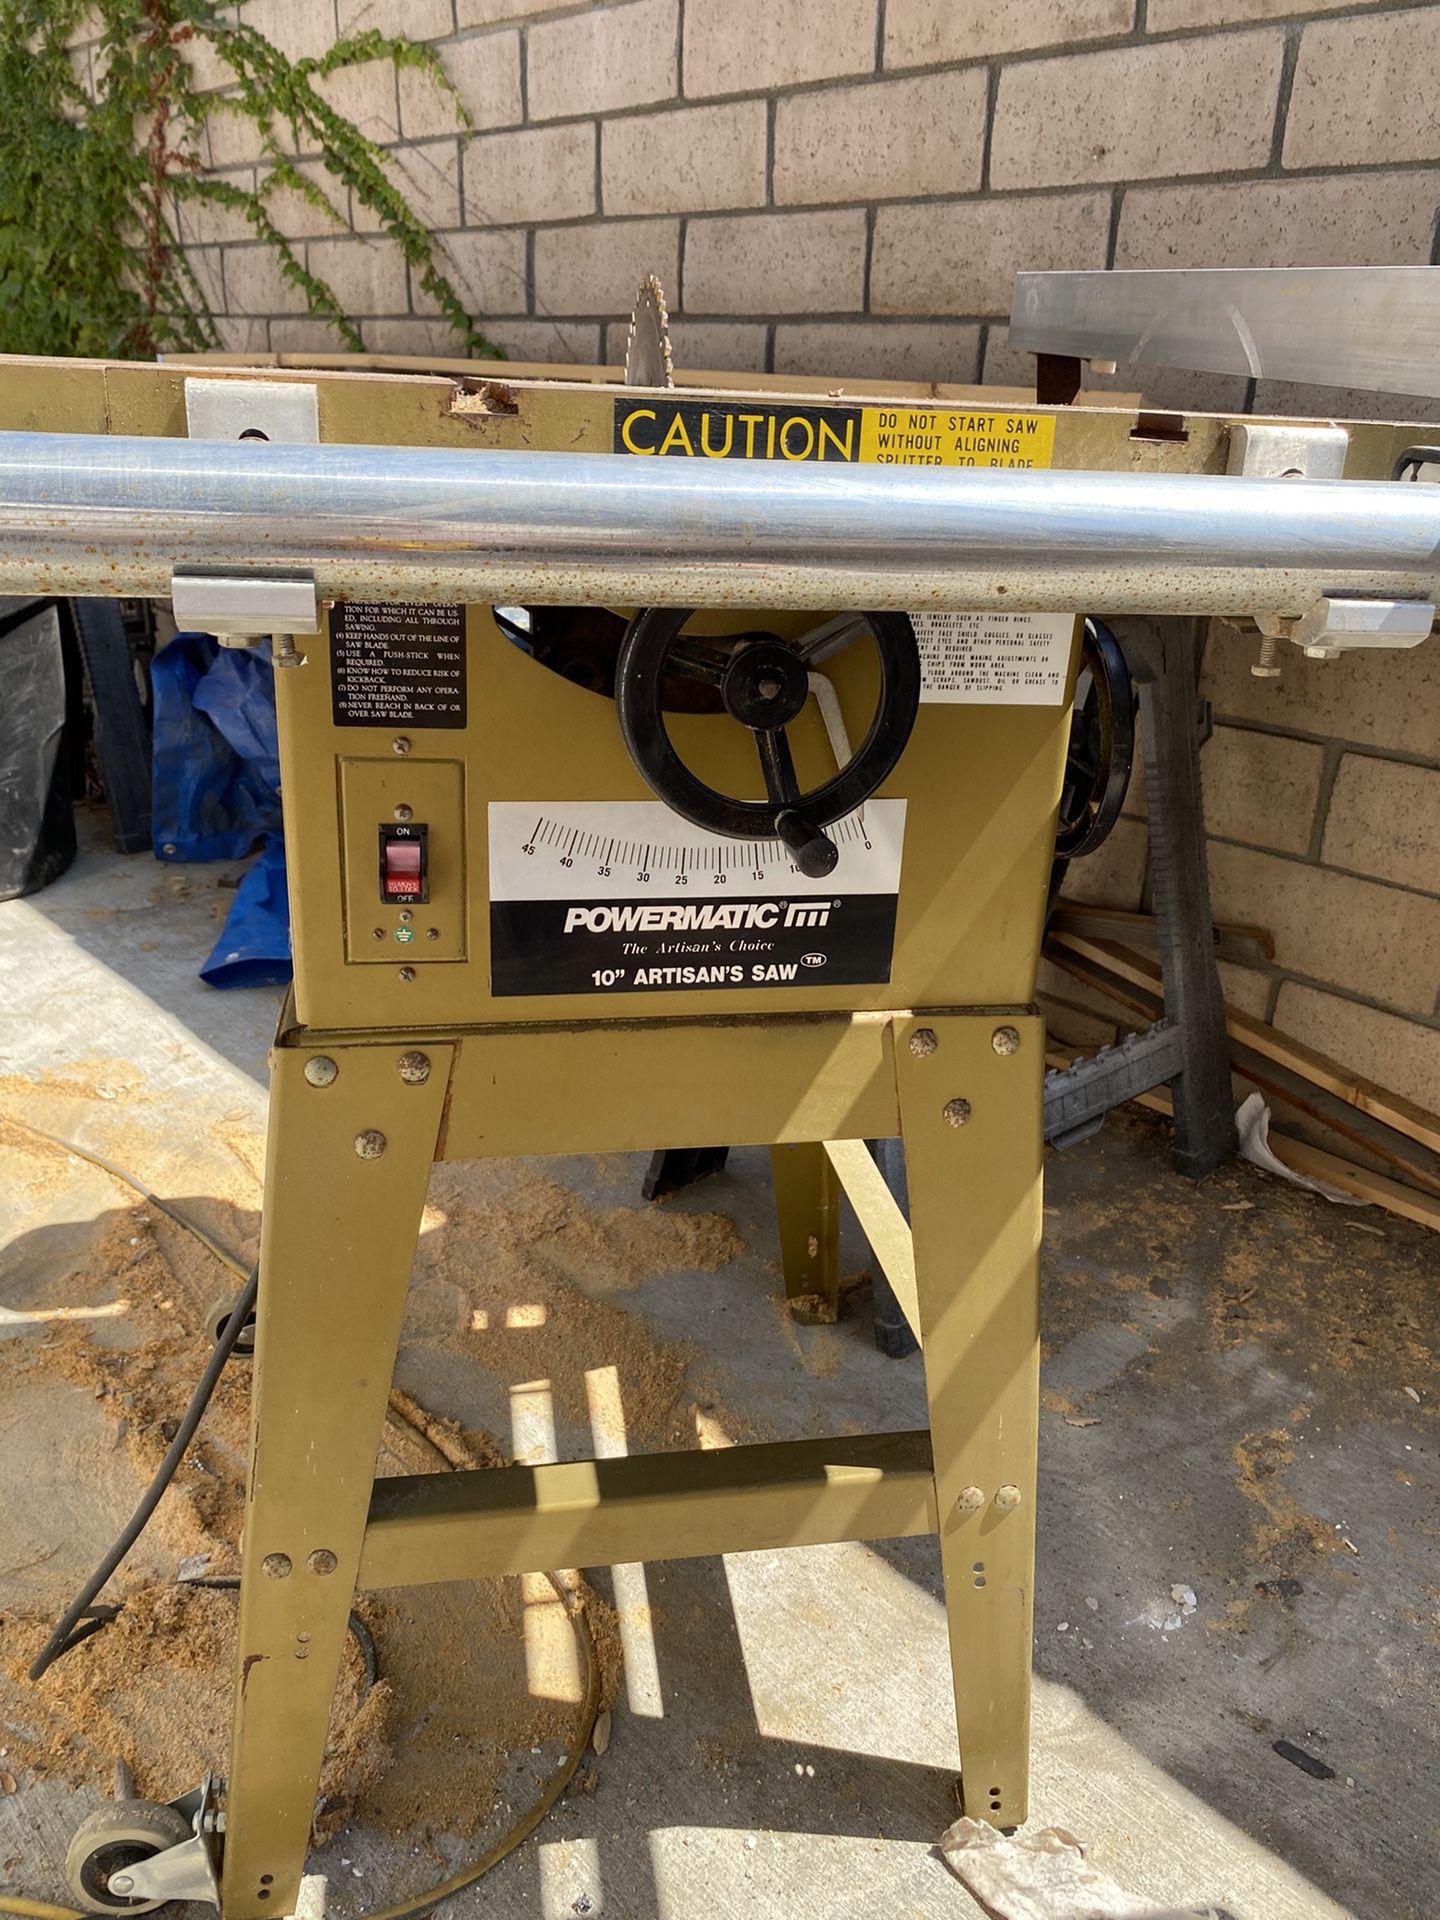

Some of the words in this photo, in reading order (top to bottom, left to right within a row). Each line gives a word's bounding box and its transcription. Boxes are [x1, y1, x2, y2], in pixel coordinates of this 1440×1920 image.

[879, 413, 896, 428] DO
[909, 415, 937, 430] NOT
[949, 417, 995, 432] START
[1006, 419, 1038, 434] SAW
[622, 409, 854, 462] CAUTION
[878, 434, 942, 450] WITHOUT
[955, 437, 1020, 453] ALIGNING
[877, 454, 942, 465] SPLITTER
[365, 606, 379, 614] FOR
[382, 607, 407, 615] WHICH
[418, 608, 435, 616] CAN
[360, 615, 401, 624] INCLUDING
[405, 616, 419, 624] ALL
[422, 617, 460, 625] THROUGH
[345, 632, 362, 640] KEEP
[384, 651, 429, 660] PUSH-STICK
[436, 652, 460, 660] WHEN
[391, 668, 402, 676] TO
[403, 669, 432, 677] REDUCE
[380, 685, 413, 693] PERFORM
[375, 702, 400, 710] REACH
[414, 703, 434, 711] BACK
[396, 827, 410, 836] ON
[521, 844, 536, 856] 45
[865, 841, 872, 850] 0
[559, 856, 573, 868] 40
[597, 866, 611, 877] 35
[752, 871, 764, 880] 15
[637, 872, 650, 883] 30
[675, 875, 688, 885] 25
[713, 874, 727, 884] 20
[622, 942, 648, 955] The
[656, 940, 722, 954] Artisan's
[729, 939, 775, 951] Choice
[633, 965, 744, 985] ARTISAN'S
[751, 964, 799, 982] SAW
